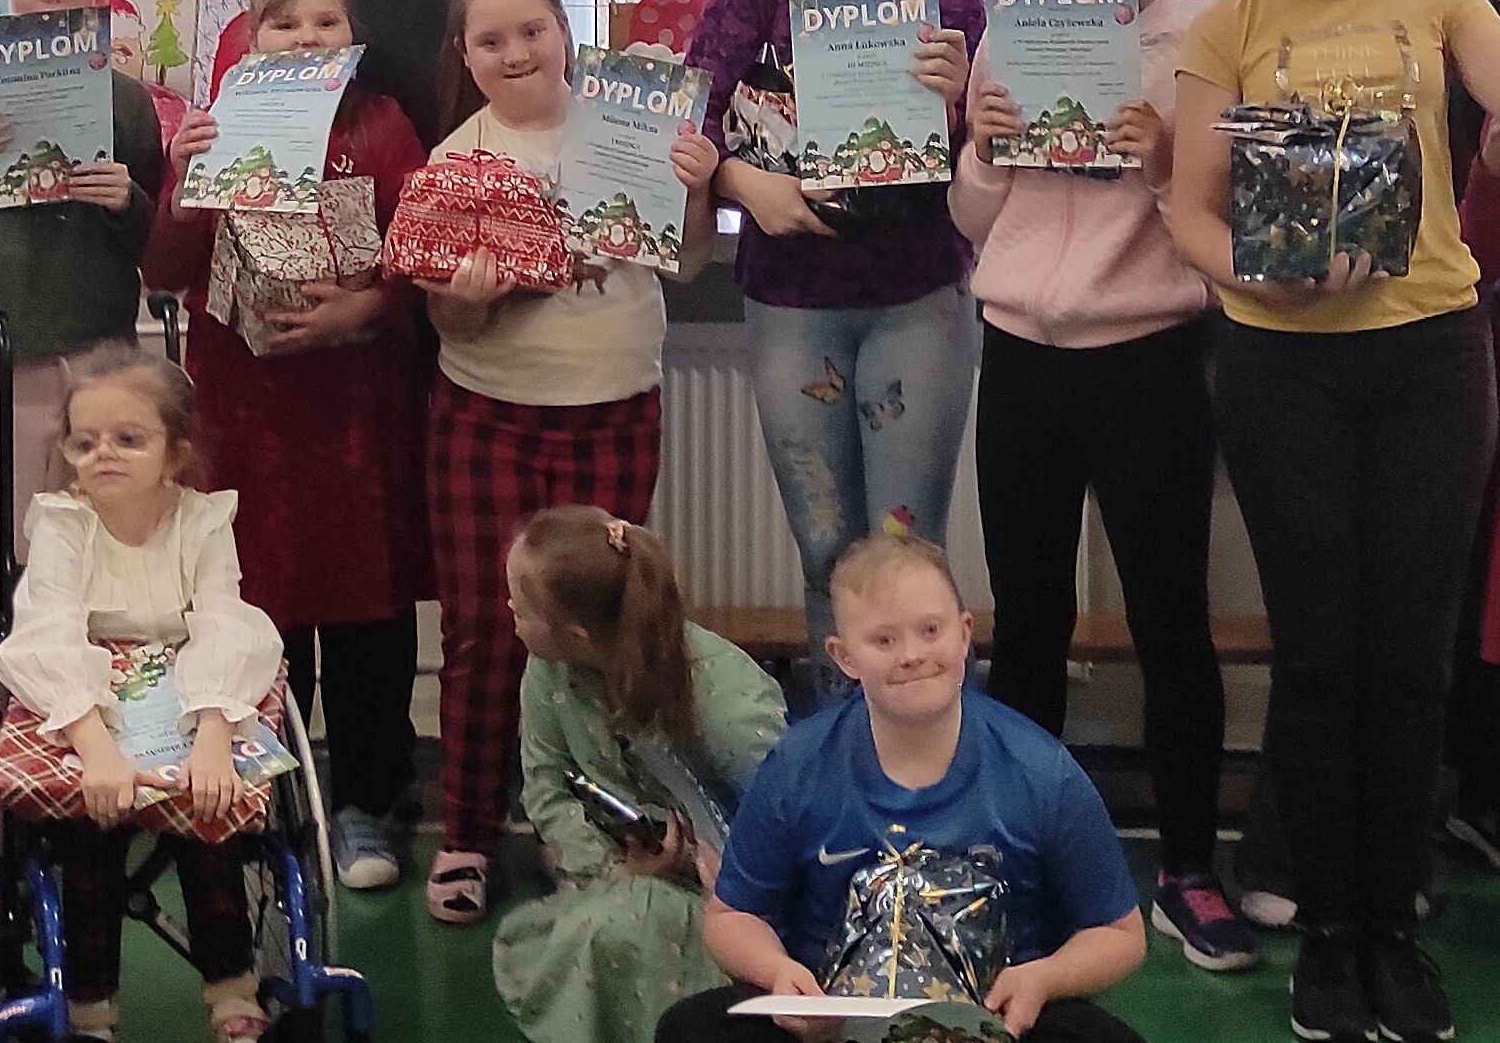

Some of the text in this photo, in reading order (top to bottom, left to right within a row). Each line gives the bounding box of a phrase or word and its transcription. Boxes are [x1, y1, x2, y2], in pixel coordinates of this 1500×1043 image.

[827, 42, 853, 52] Anna
[235, 63, 344, 87] DYPLOM
[582, 74, 694, 120] DYPLOM
